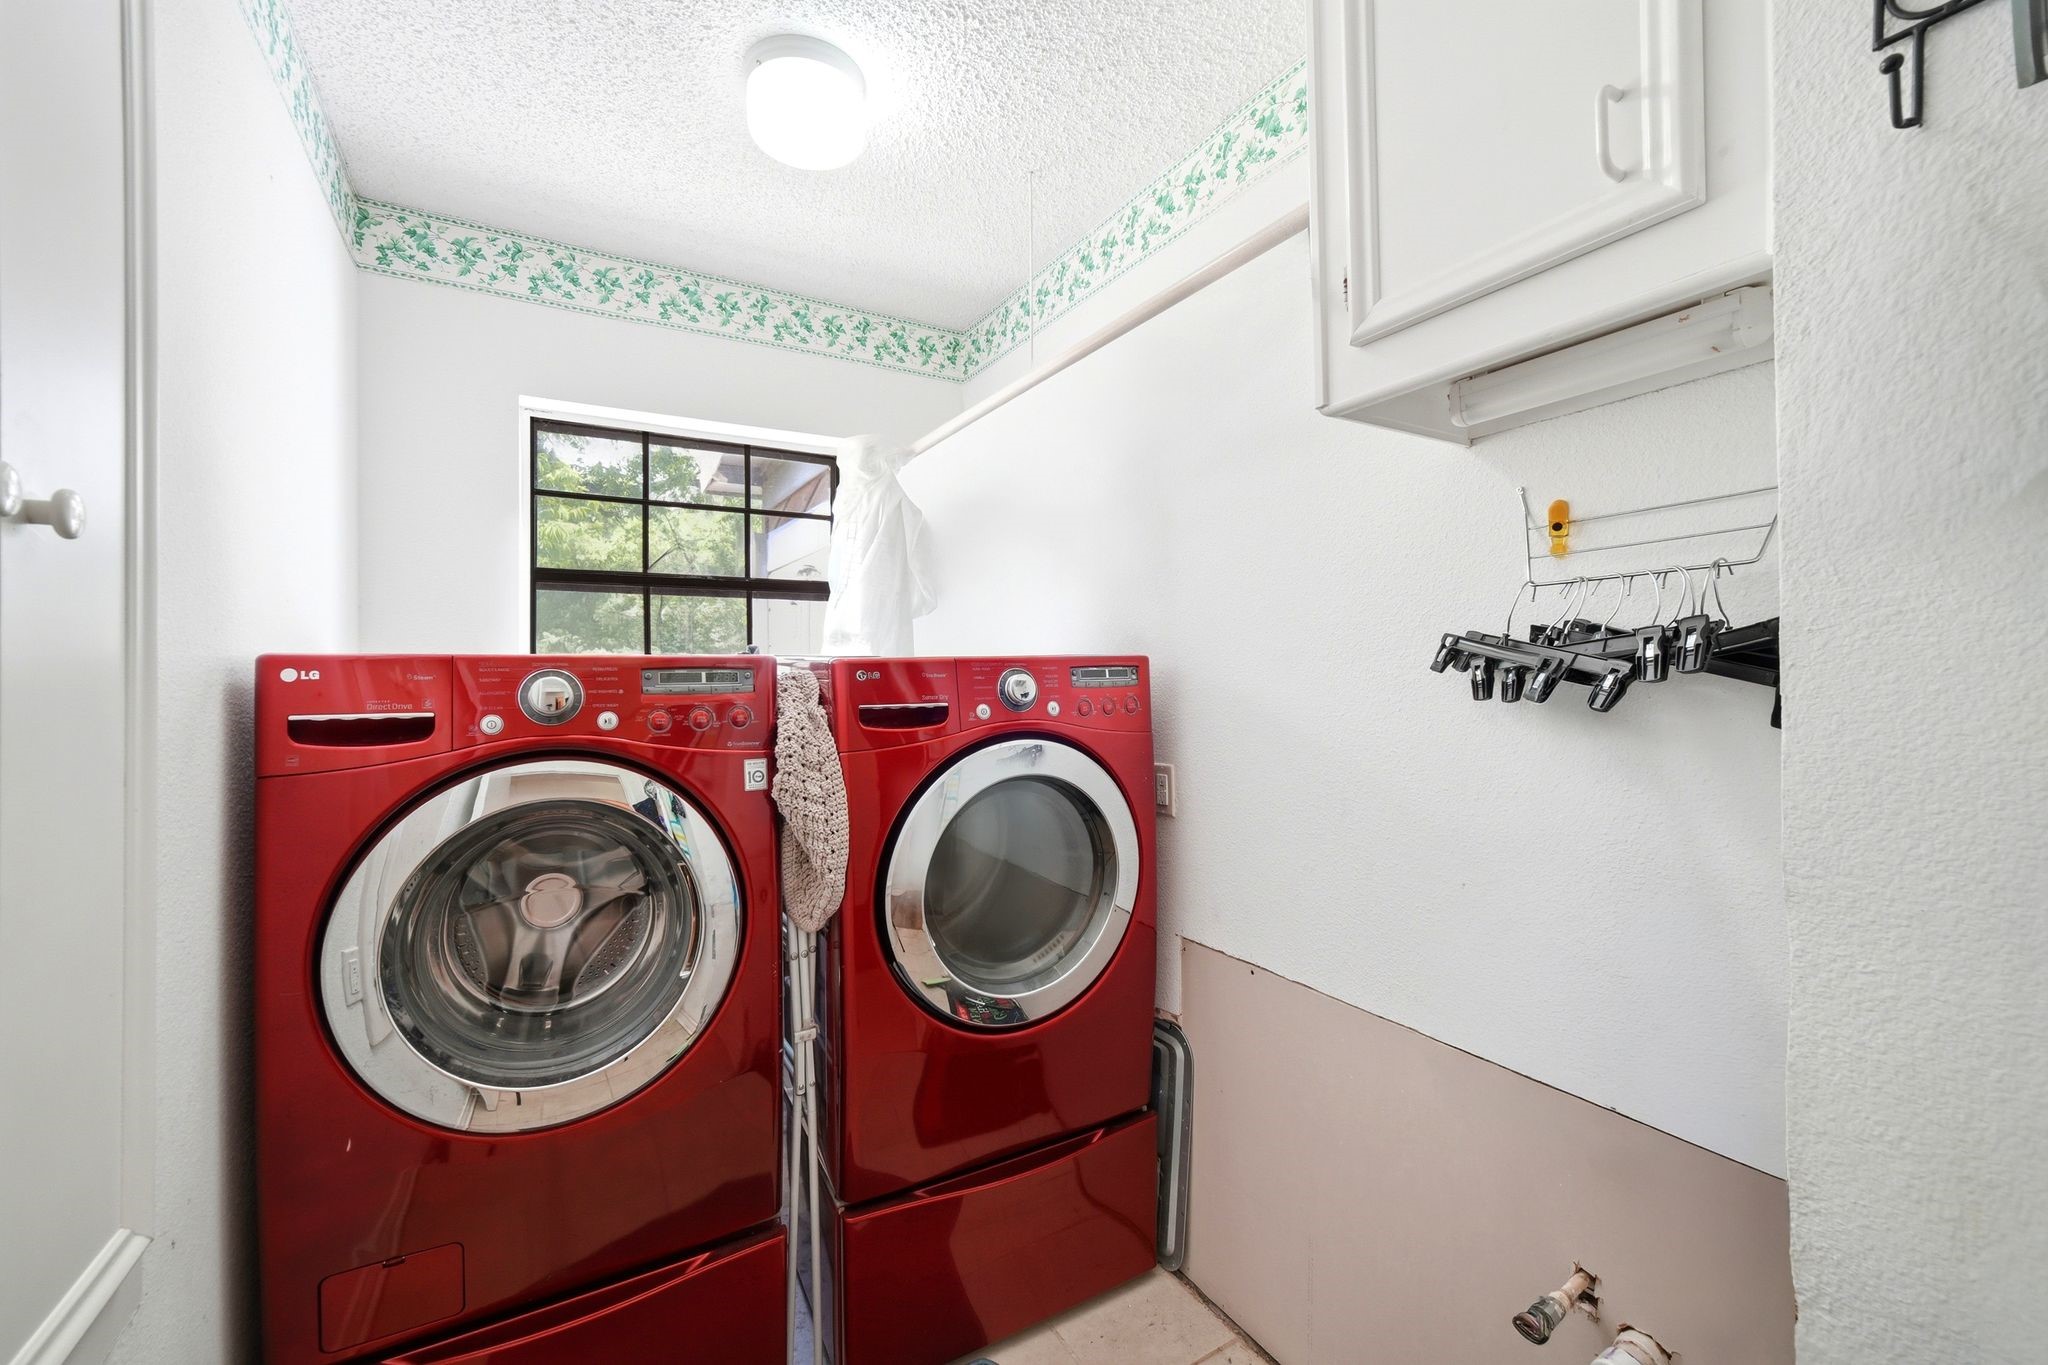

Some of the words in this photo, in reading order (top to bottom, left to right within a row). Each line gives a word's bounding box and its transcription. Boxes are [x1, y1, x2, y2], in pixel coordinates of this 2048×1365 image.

[300, 670, 320, 680] LG
[867, 671, 881, 680] LG
[391, 702, 412, 710] Drive
